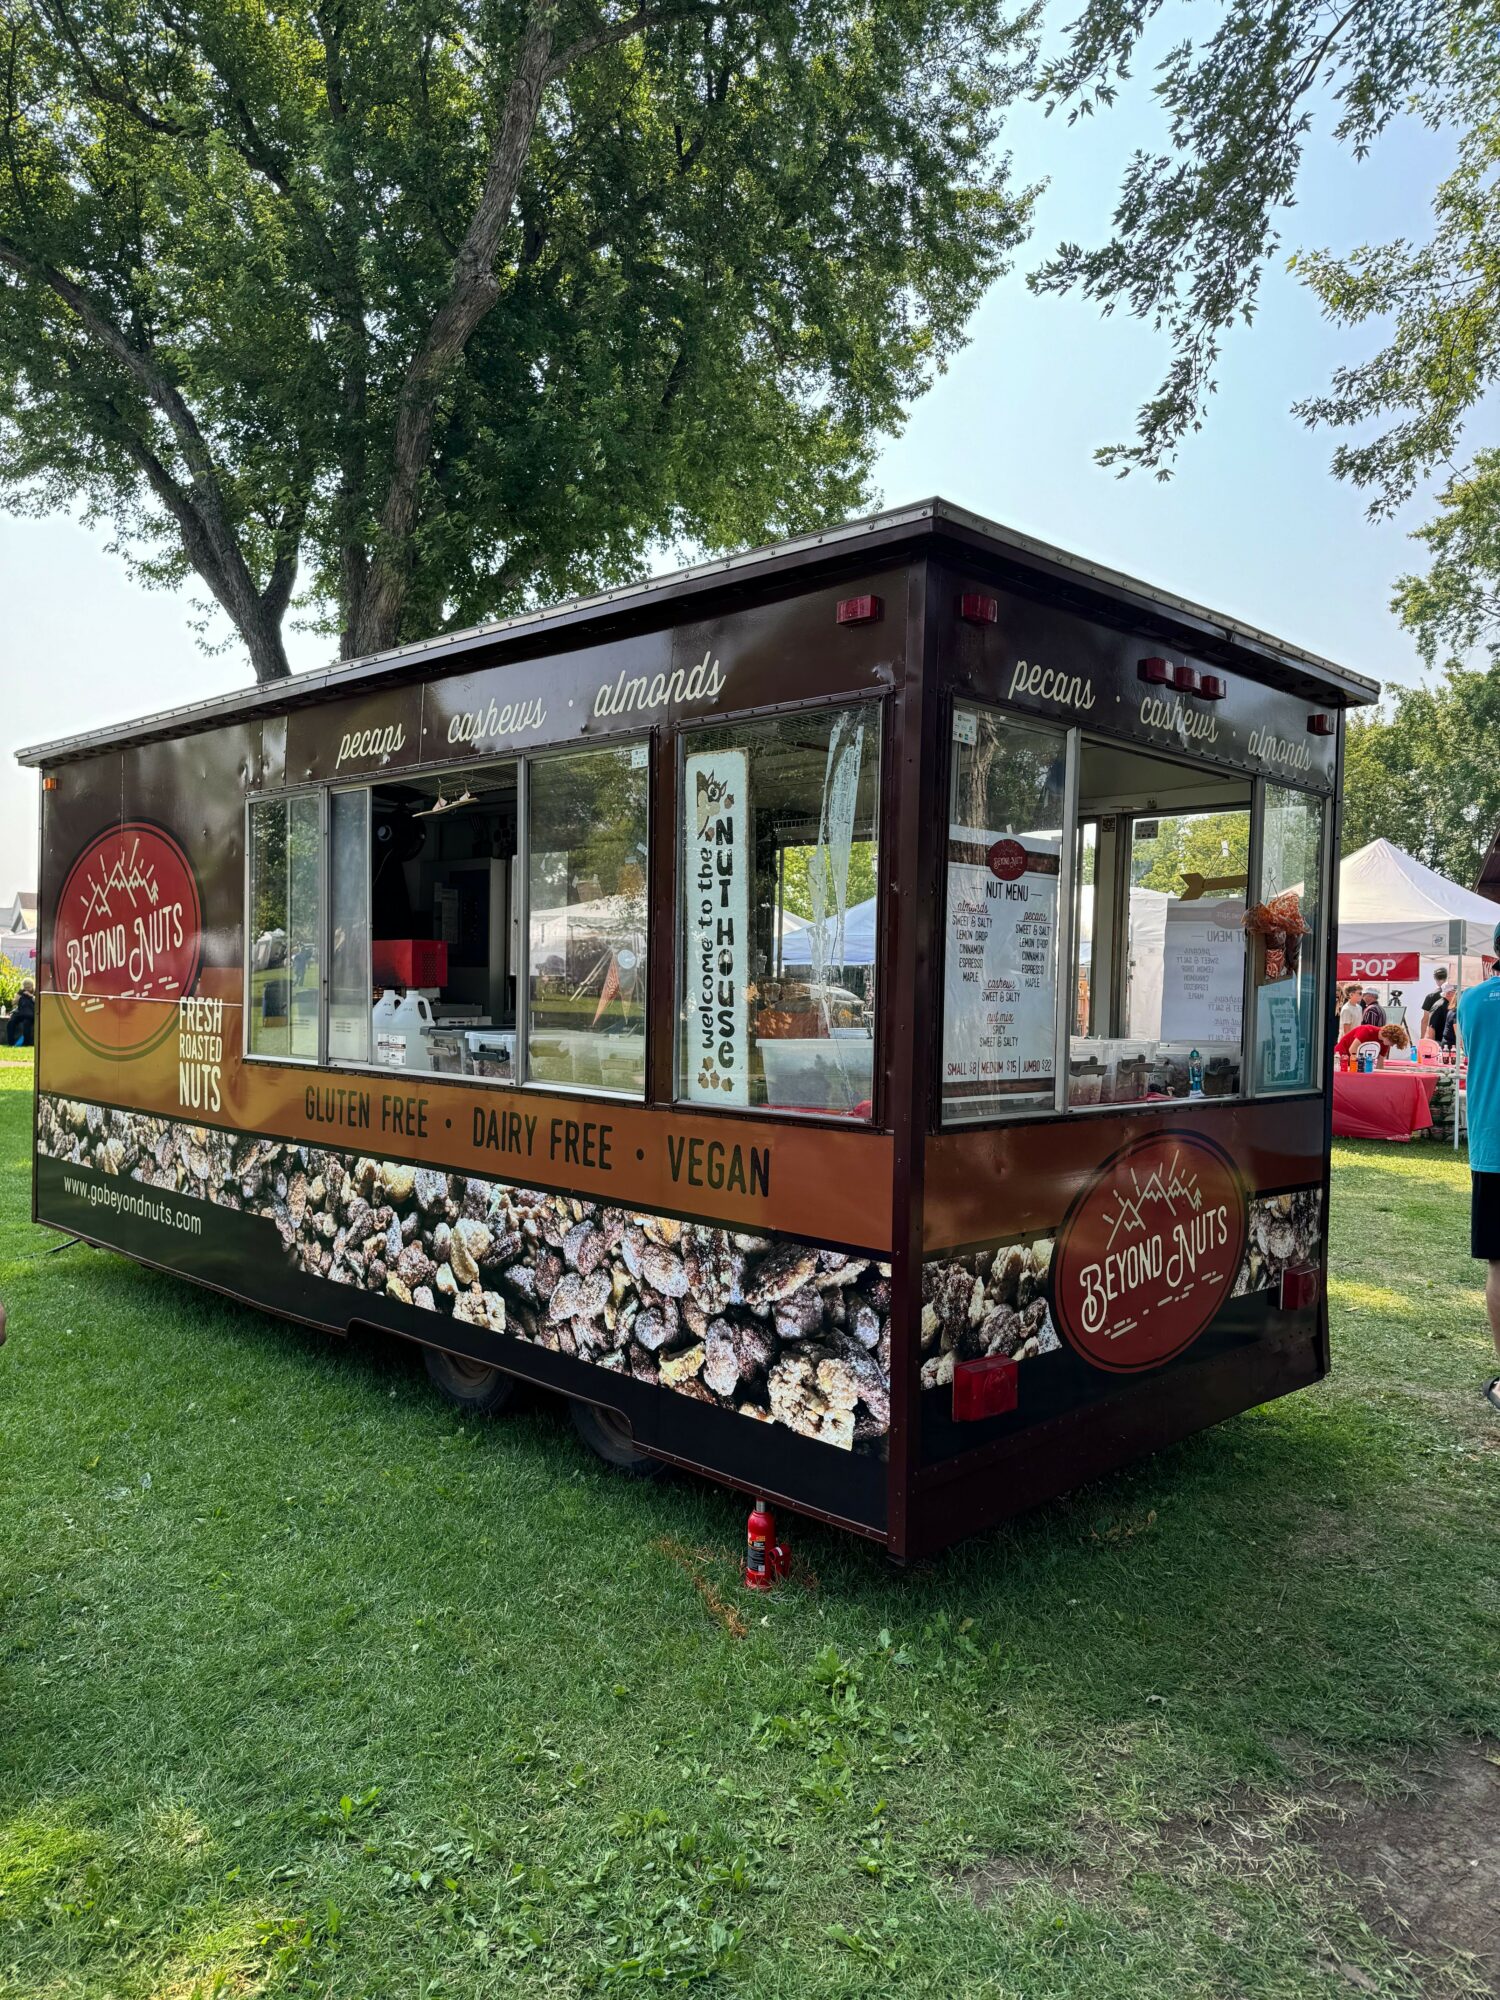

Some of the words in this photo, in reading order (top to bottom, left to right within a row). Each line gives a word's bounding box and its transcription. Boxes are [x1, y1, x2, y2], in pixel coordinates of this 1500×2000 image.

[336, 723, 406, 769] pecans
[447, 698, 547, 744] cashews
[594, 651, 726, 717] almonds
[1008, 659, 1096, 710] pecans
[1140, 695, 1219, 743] cashews
[1248, 725, 1312, 771] almonds
[698, 847, 713, 892] the
[986, 881, 1003, 898] NUT
[1006, 884, 1029, 901] MENU
[698, 899, 713, 929] to
[67, 926, 126, 1000] BEYOND
[129, 903, 183, 981] NUTS
[1351, 959, 1396, 977] POP
[180, 997, 223, 1034] FRESH
[697, 937, 714, 1049] welcome
[180, 1033, 223, 1062] ROASTED
[948, 1062, 967, 1076] SMALL
[970, 1062, 977, 1074] $8
[1007, 1060, 1017, 1072] $15
[1022, 1060, 1040, 1072] JUMBO
[1042, 1059, 1052, 1071] $22
[180, 1063, 222, 1112] NUTS
[305, 1085, 370, 1129] GLUTEN
[382, 1095, 428, 1138] FREE
[473, 1107, 537, 1156] DAIRY
[550, 1119, 613, 1170] FREE
[668, 1135, 769, 1198] VEGAN
[64, 1173, 202, 1234] www.gobeyondnuts.com
[1079, 1234, 1162, 1333] BEYOND
[1166, 1205, 1228, 1288] NUTS
